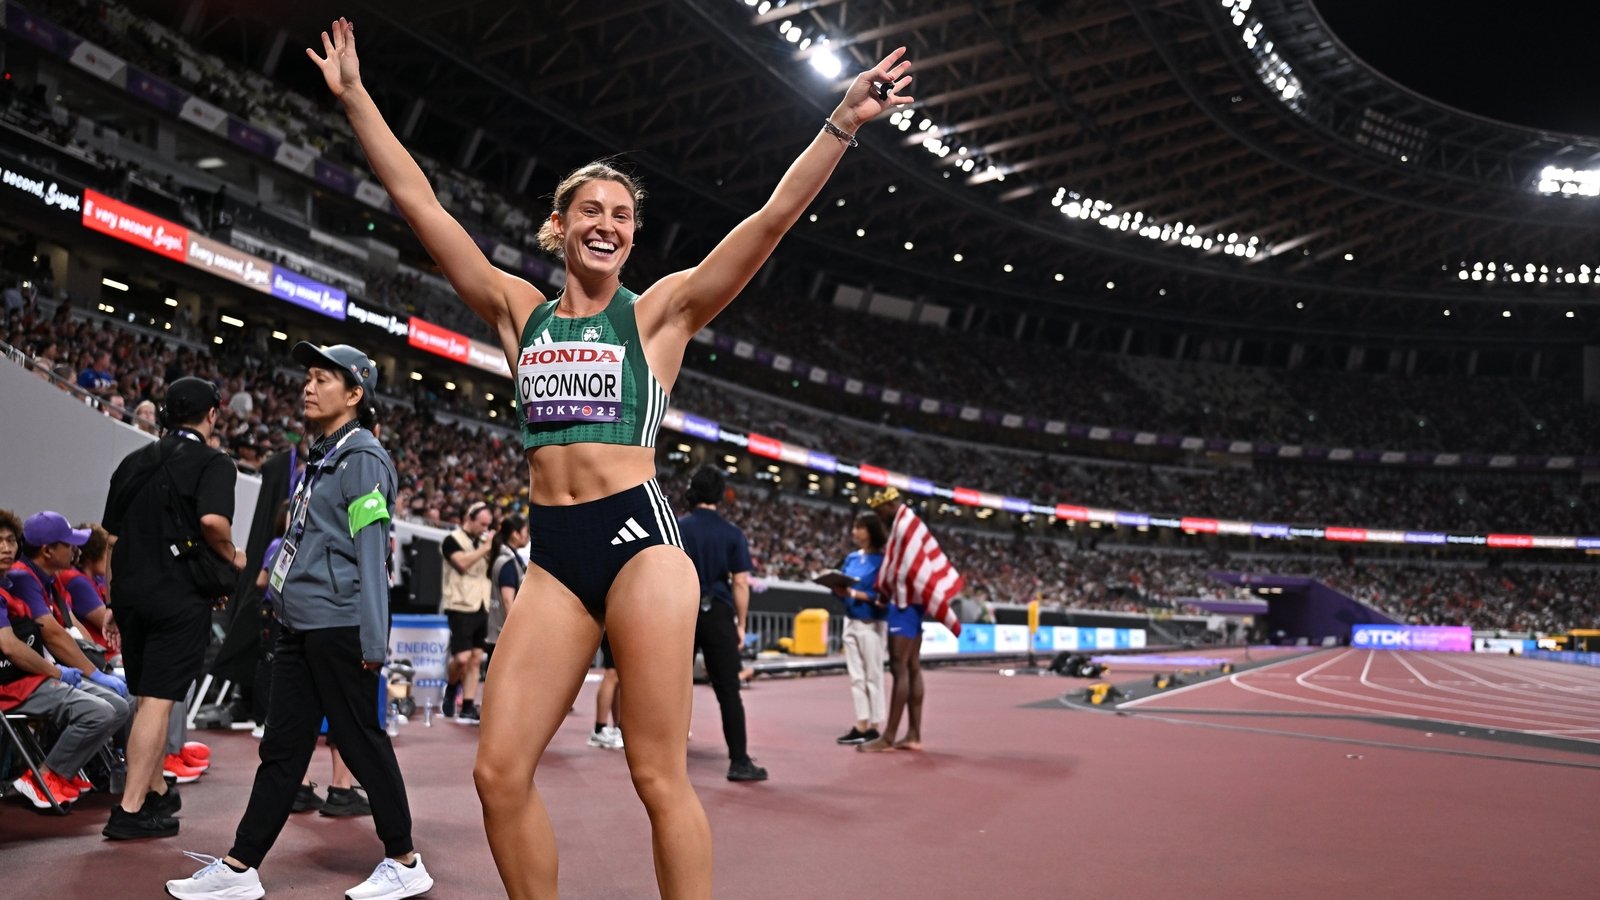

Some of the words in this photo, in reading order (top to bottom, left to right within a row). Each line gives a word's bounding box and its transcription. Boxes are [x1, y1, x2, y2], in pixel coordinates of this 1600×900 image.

[3, 169, 45, 199] second,
[45, 182, 80, 212] Sugoi.
[118, 216, 153, 240] second,
[520, 349, 619, 366] HONDA
[522, 373, 616, 400] O'CONNOR
[596, 406, 616, 417] 25
[1367, 629, 1411, 645] TDK
[397, 641, 445, 654] ENERGY
